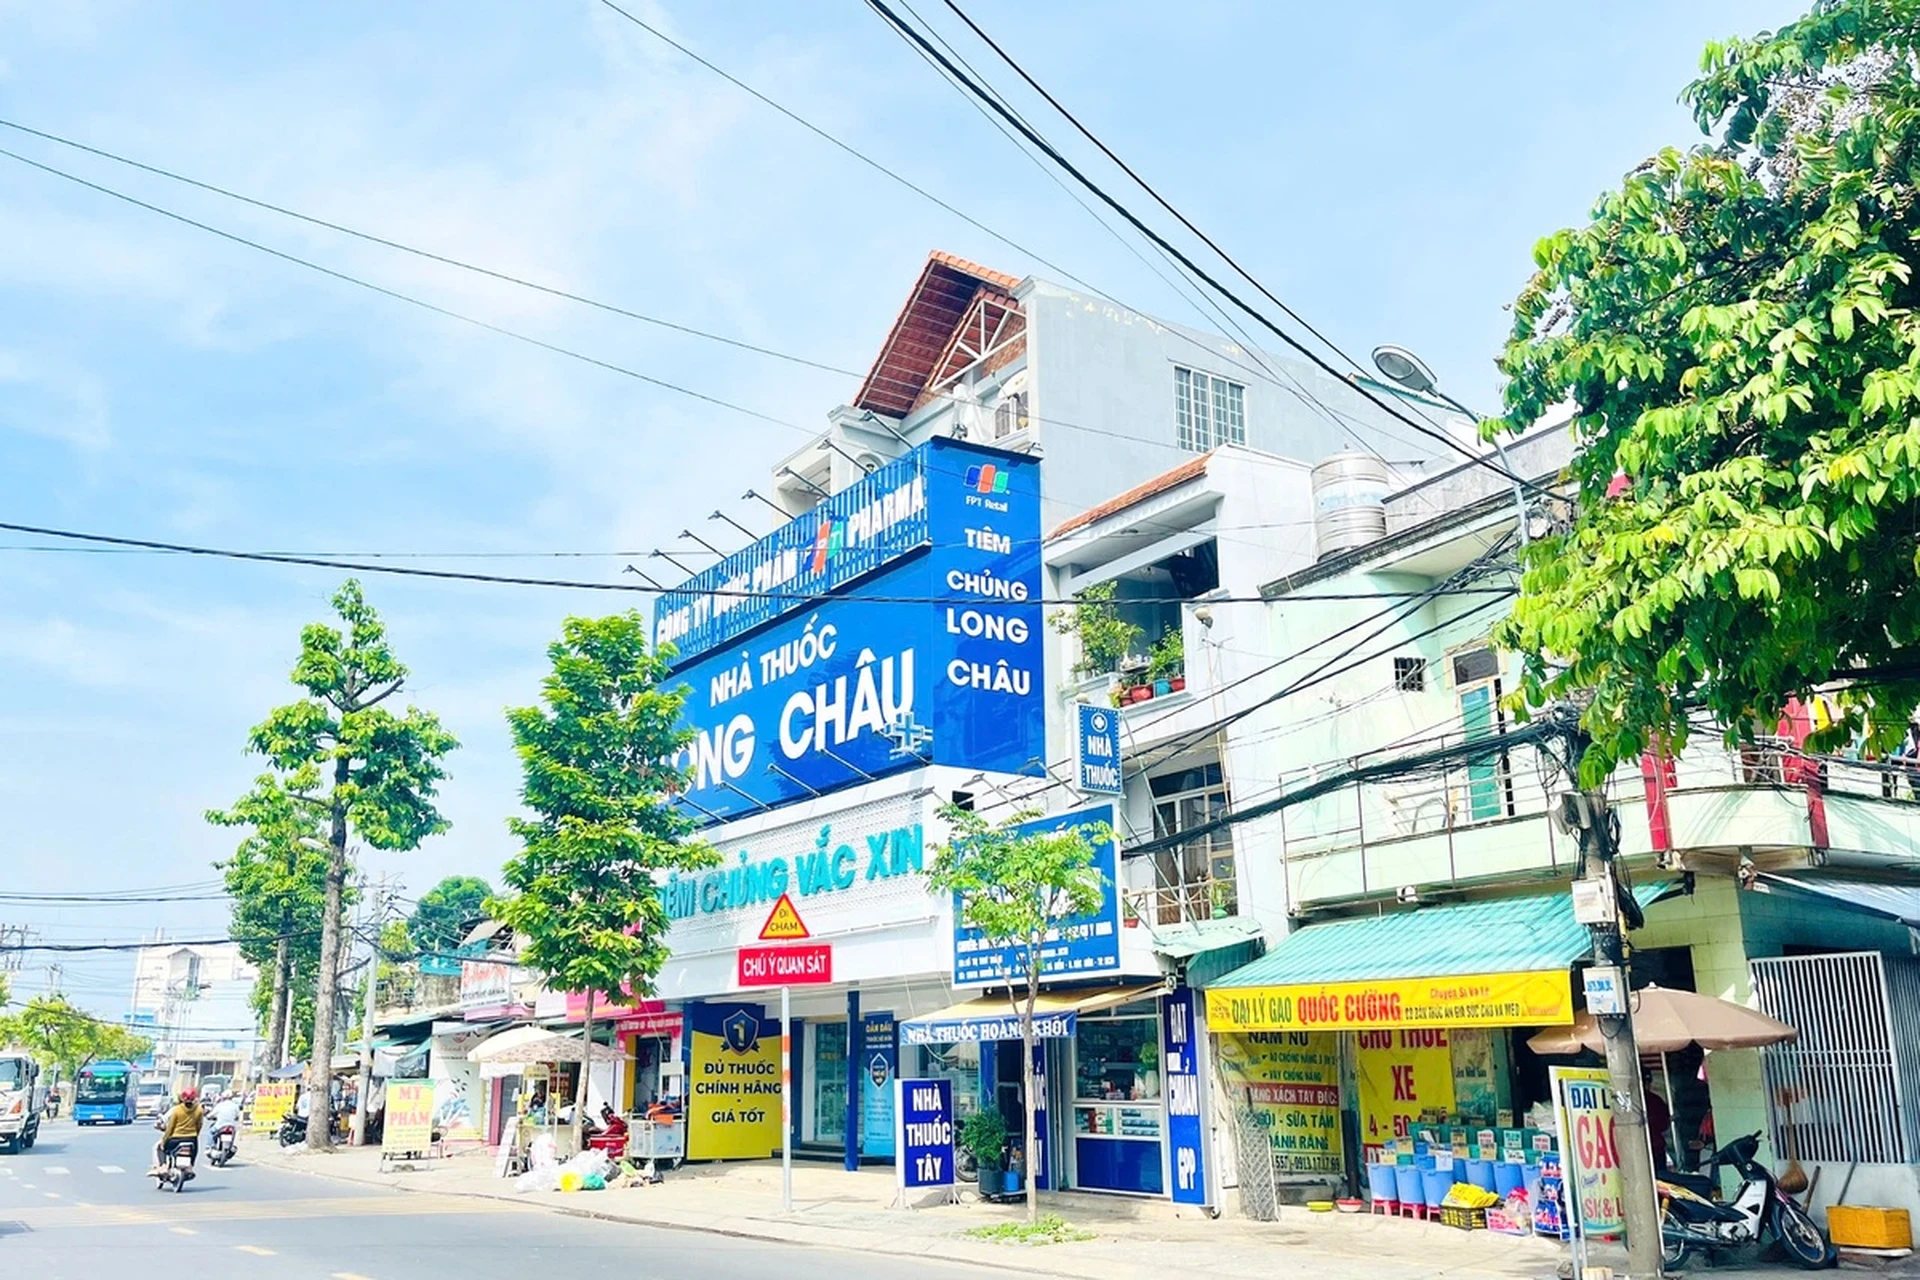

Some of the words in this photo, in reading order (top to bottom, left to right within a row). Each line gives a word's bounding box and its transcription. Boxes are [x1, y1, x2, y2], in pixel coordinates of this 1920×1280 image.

[965, 494, 982, 507] FPT
[984, 498, 1009, 513] Retail
[692, 594, 711, 628] TY
[848, 475, 926, 547] PHARMA
[964, 525, 1012, 555] TIÊM
[946, 568, 1029, 601] CHỦNG
[946, 607, 1030, 644] LONG
[710, 650, 754, 708] NHÀ
[759, 613, 838, 687] THUỐC
[946, 659, 1031, 697] CHÂU
[665, 713, 756, 796] ONG
[778, 647, 915, 760] CHÂU
[1087, 733, 1113, 758] NHÀ
[1084, 760, 1118, 788] THUỐC
[700, 851, 790, 913] CHỦNG
[795, 824, 857, 897] VẮC
[865, 823, 923, 881] XIN
[743, 954, 767, 977] CHÚ
[769, 954, 778, 975] Ý
[777, 956, 806, 976] QUAN
[806, 953, 828, 974] SÁT
[1231, 997, 1251, 1028] ĐẠI
[1253, 992, 1265, 1024] LÝ
[1269, 996, 1292, 1028] GẠO
[1297, 987, 1340, 1026] QUỐC
[935, 1019, 979, 1042] THUỐC
[1248, 1031, 1283, 1044] NAM
[703, 1058, 727, 1075] ĐỦ
[728, 1058, 775, 1075] THUỐC
[695, 1078, 740, 1095] CHÍNH
[1273, 1085, 1297, 1104] XÁCH
[1298, 1089, 1315, 1104] TAY
[1391, 1065, 1417, 1101] XE
[911, 1083, 943, 1112] NHÀ
[1571, 1087, 1598, 1114] ĐẠI
[711, 1109, 735, 1124] GIÁ
[738, 1107, 766, 1123] TỐT
[1286, 1110, 1308, 1127] SỮA
[1369, 1113, 1378, 1137] 4
[905, 1115, 951, 1147] THUỐC
[915, 1153, 942, 1182] TÂY
[1603, 1197, 1613, 1218] &
